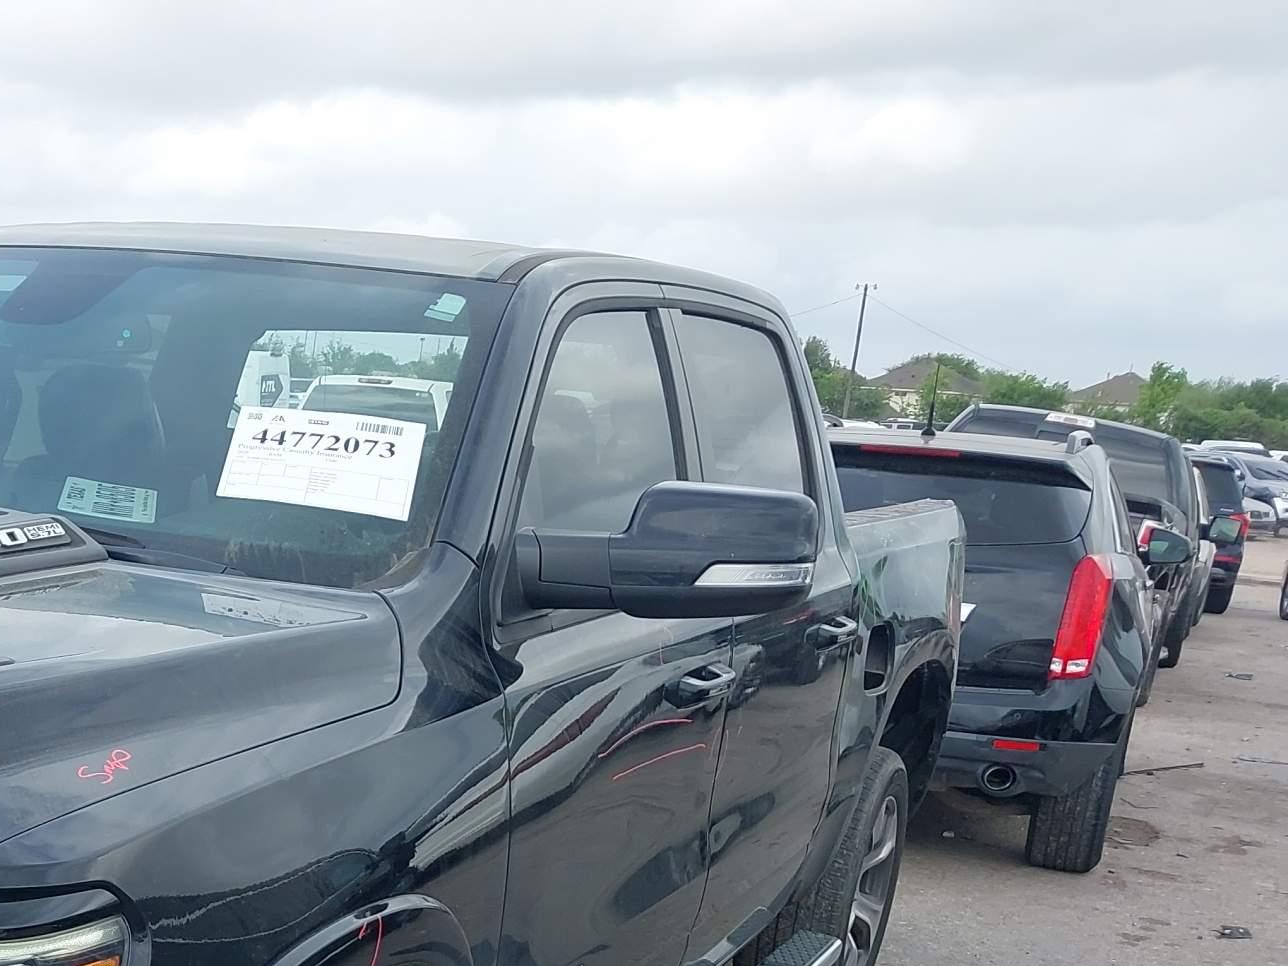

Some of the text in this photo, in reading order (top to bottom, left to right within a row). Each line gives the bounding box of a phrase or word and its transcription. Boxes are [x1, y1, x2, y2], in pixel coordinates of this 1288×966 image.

[251, 428, 396, 459] 44772073
[26, 523, 61, 533] HEMI
[30, 529, 63, 538] 5.7L
